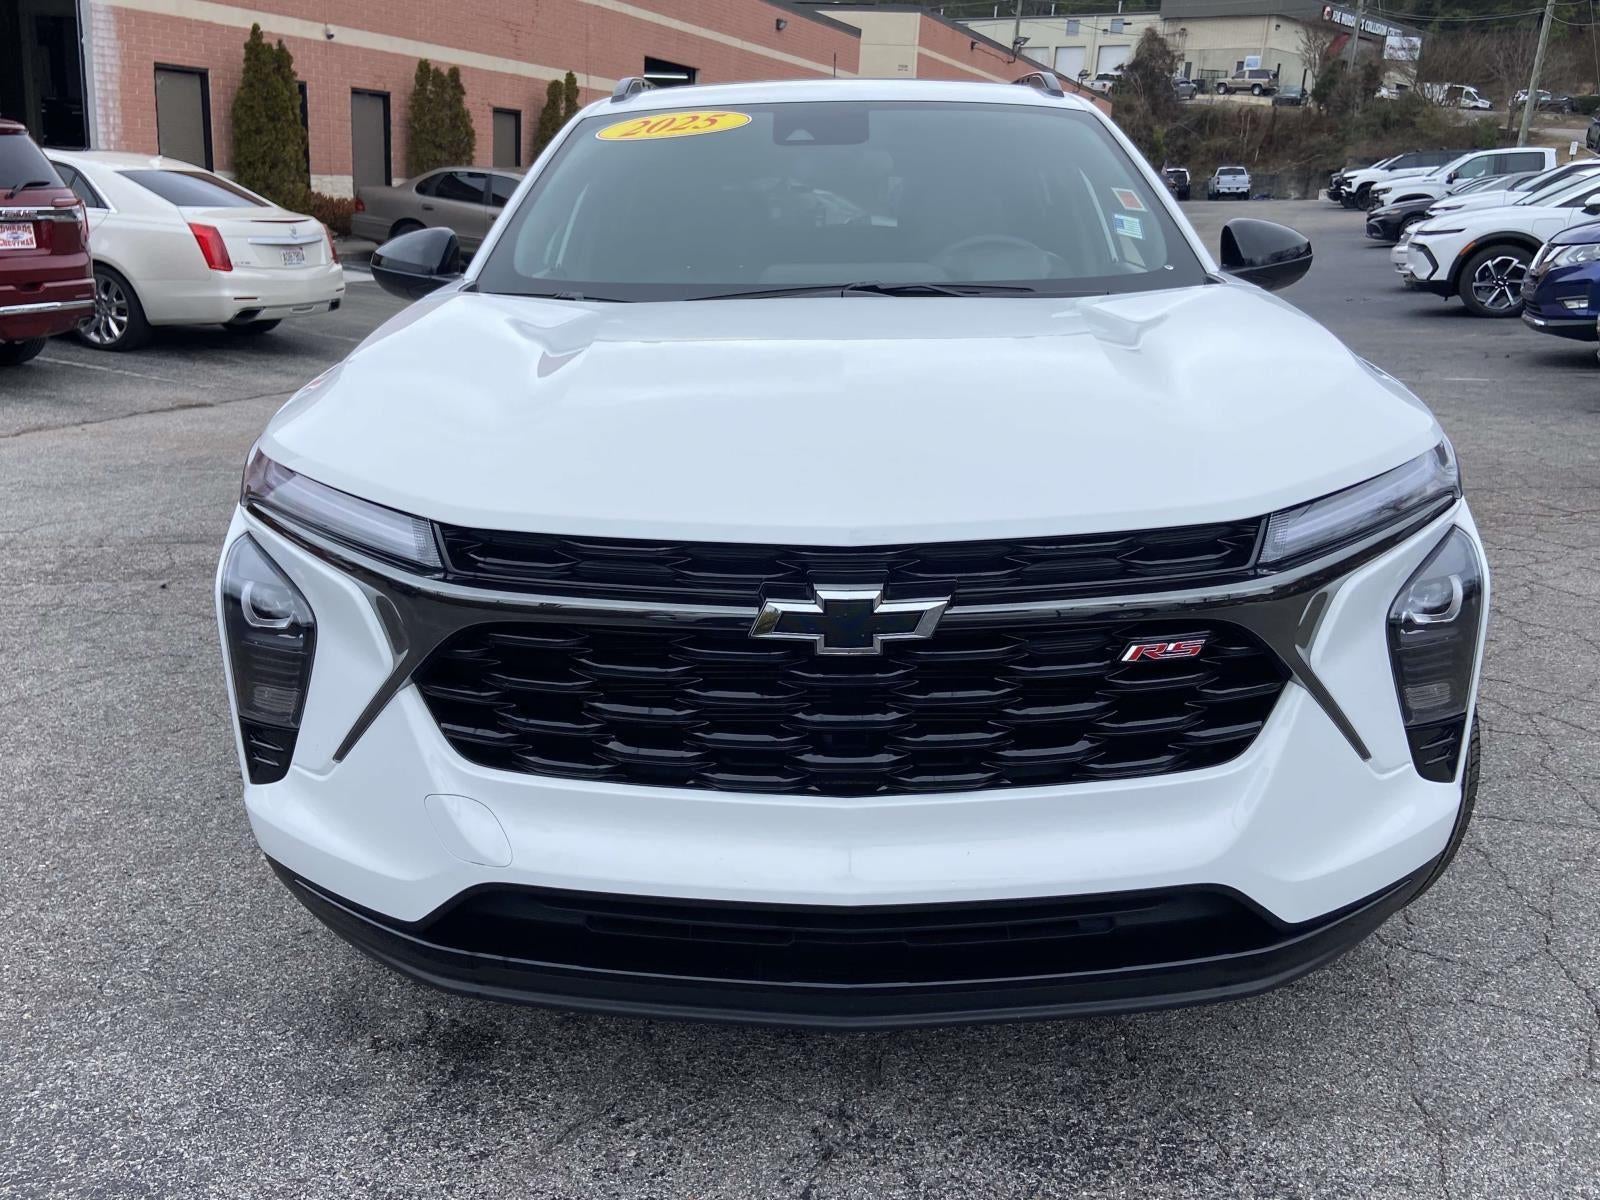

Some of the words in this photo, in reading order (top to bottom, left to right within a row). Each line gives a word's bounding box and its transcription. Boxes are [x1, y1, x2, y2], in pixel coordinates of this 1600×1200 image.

[1365, 20, 1387, 36] COLLISION
[619, 114, 727, 137] 2025
[0, 224, 32, 234] DWARDS
[1121, 639, 1206, 662] RS
